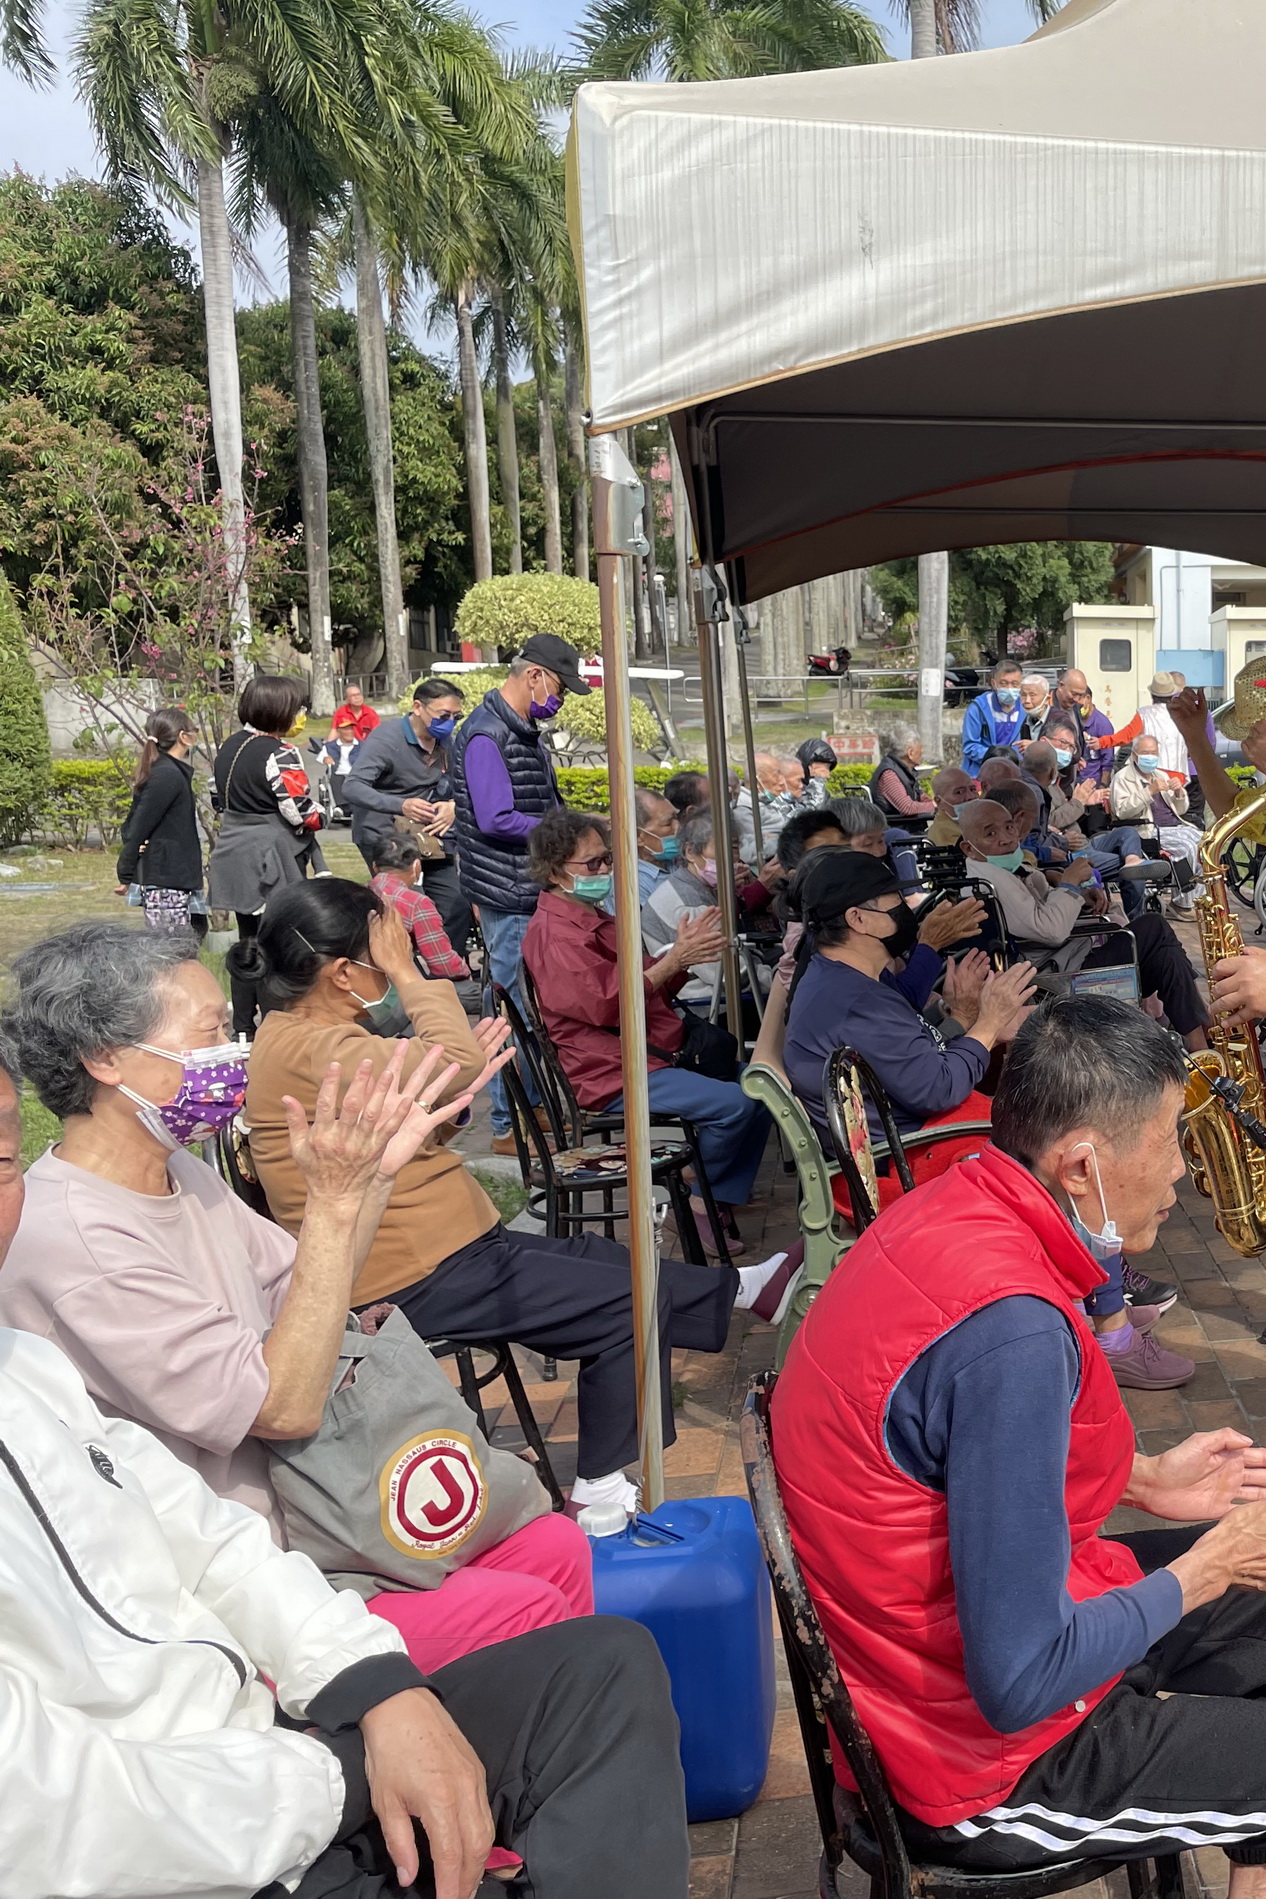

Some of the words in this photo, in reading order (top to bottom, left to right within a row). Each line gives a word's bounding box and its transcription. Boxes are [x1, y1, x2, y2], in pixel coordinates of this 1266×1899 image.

[390, 1480, 398, 1501] JEAN
[431, 1439, 457, 1449] CIRCLE
[421, 1457, 465, 1527] J
